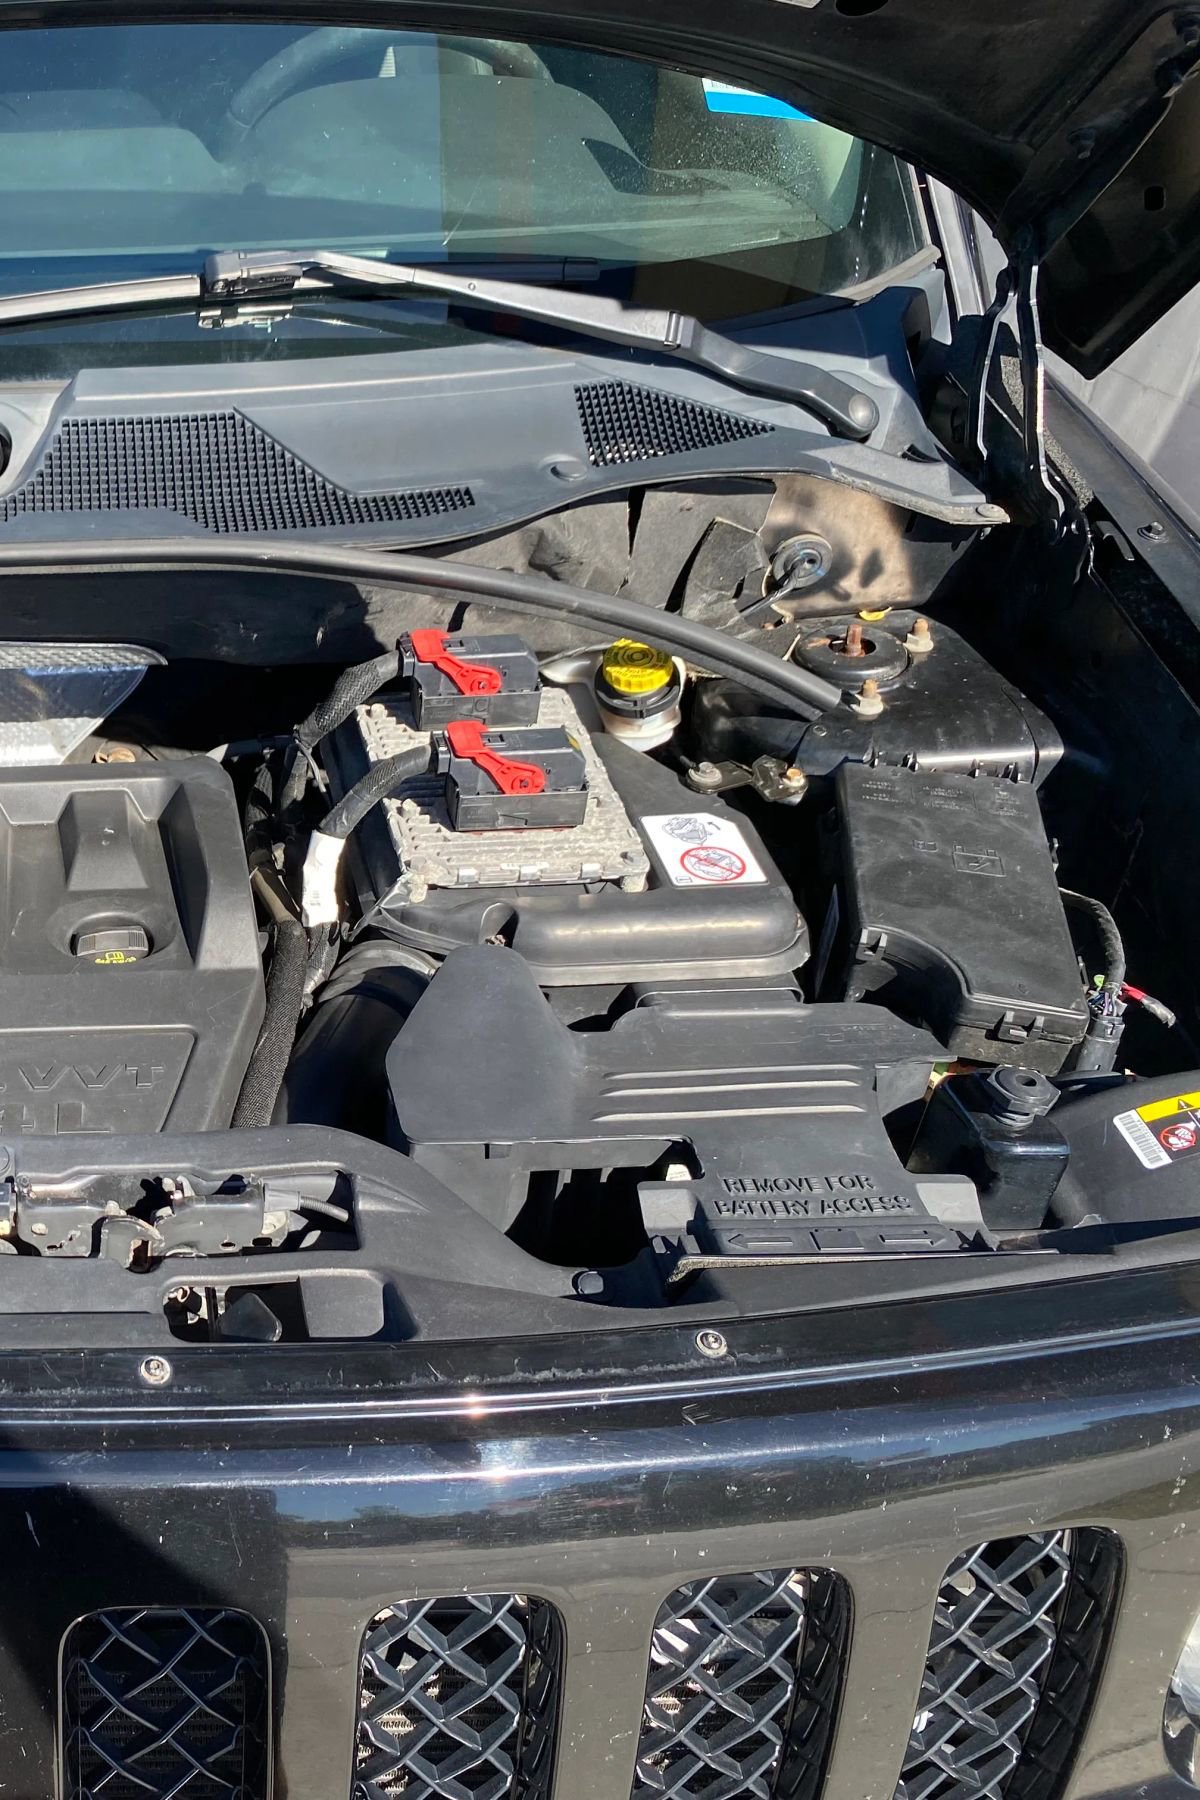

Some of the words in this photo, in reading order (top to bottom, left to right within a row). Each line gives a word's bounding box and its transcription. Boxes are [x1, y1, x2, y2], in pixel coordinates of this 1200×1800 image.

[17, 1063, 165, 1090] VVT
[723, 1176, 822, 1194] REMOVE
[825, 1174, 875, 1191] FOR
[713, 1200, 815, 1217] BATTERY
[820, 1196, 913, 1216] ACCESS
